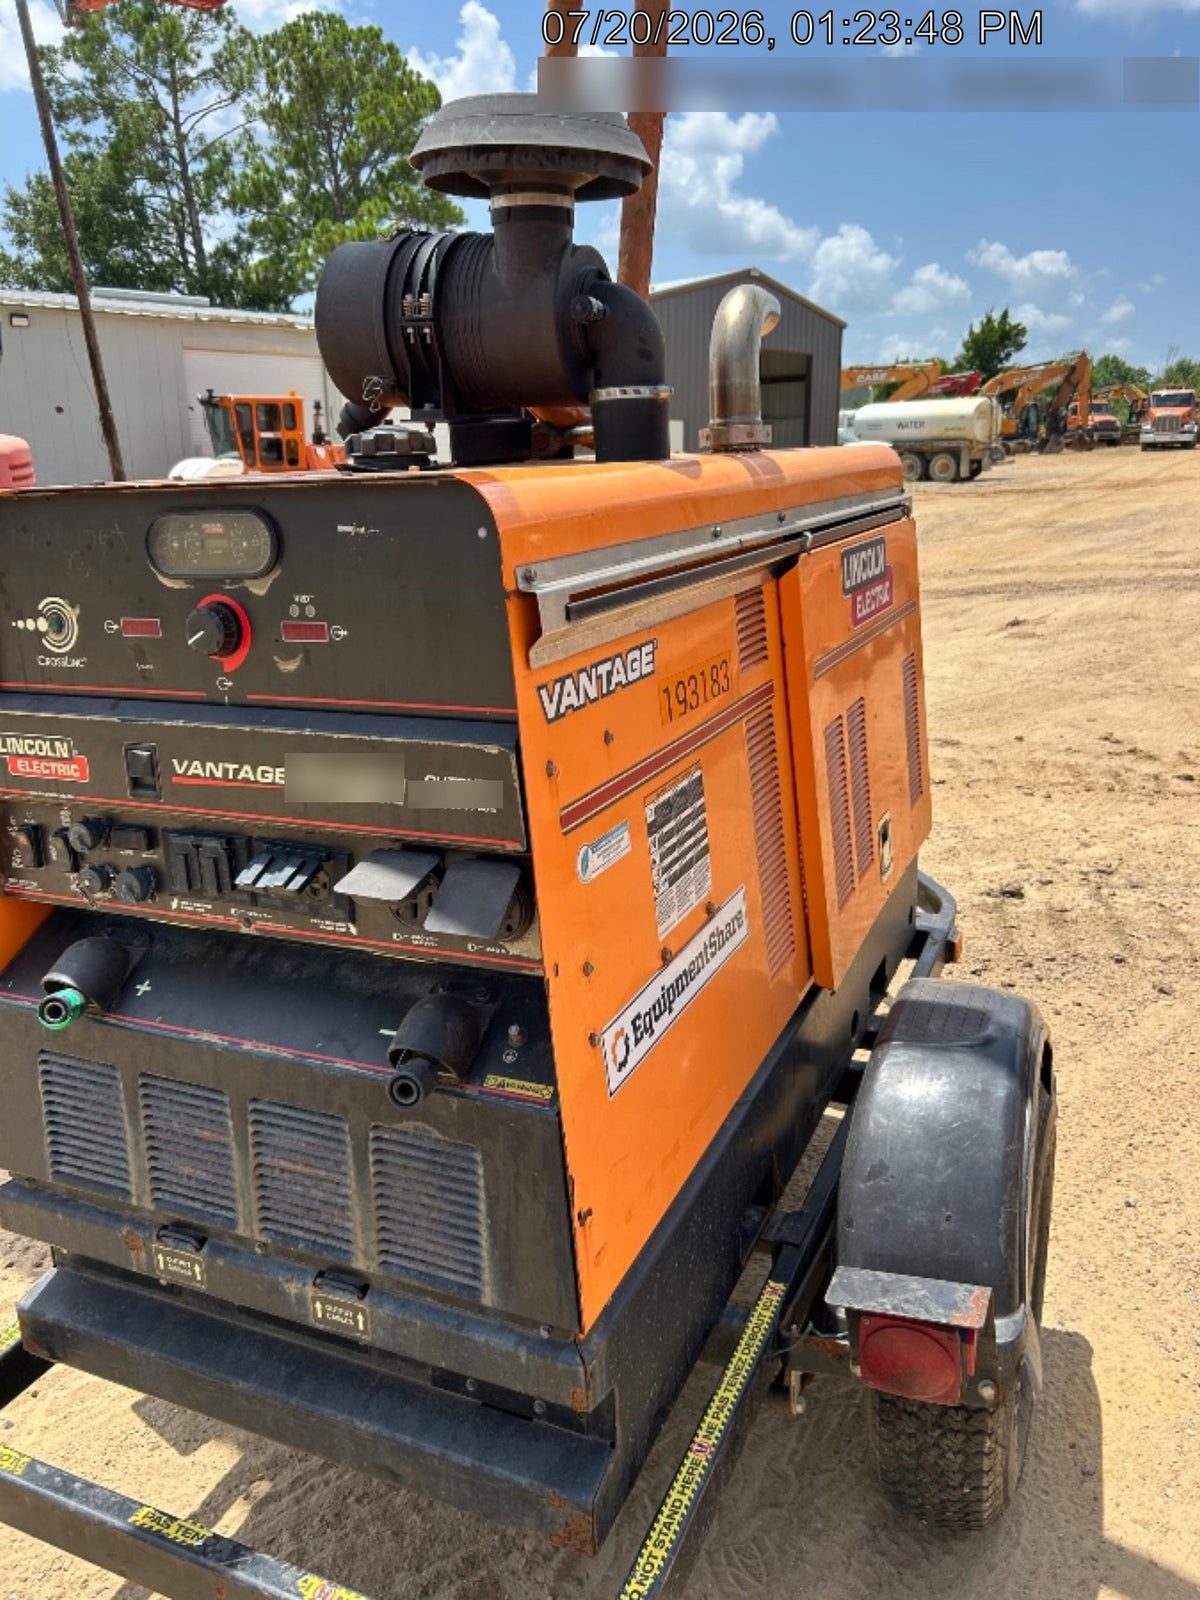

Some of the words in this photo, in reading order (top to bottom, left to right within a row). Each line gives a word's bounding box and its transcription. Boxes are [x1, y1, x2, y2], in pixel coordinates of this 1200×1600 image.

[896, 421, 926, 430] WATER
[843, 543, 885, 590] LINCOLN
[539, 641, 656, 720] VANTAGE
[662, 658, 730, 722] 193183
[0, 736, 70, 758] LINCOLN
[17, 759, 81, 778] ELECTRIC
[172, 757, 285, 784] VANTAGE
[630, 909, 744, 1048] EquipmentShare
[702, 1421, 718, 1440] NE
[711, 1395, 730, 1421] PAS
[741, 1311, 767, 1355] DEBOUT
[141, 1510, 172, 1529] PAS
[635, 1549, 659, 1587] NOT
[652, 1497, 684, 1550] STAND
[677, 1457, 702, 1496] HERE
